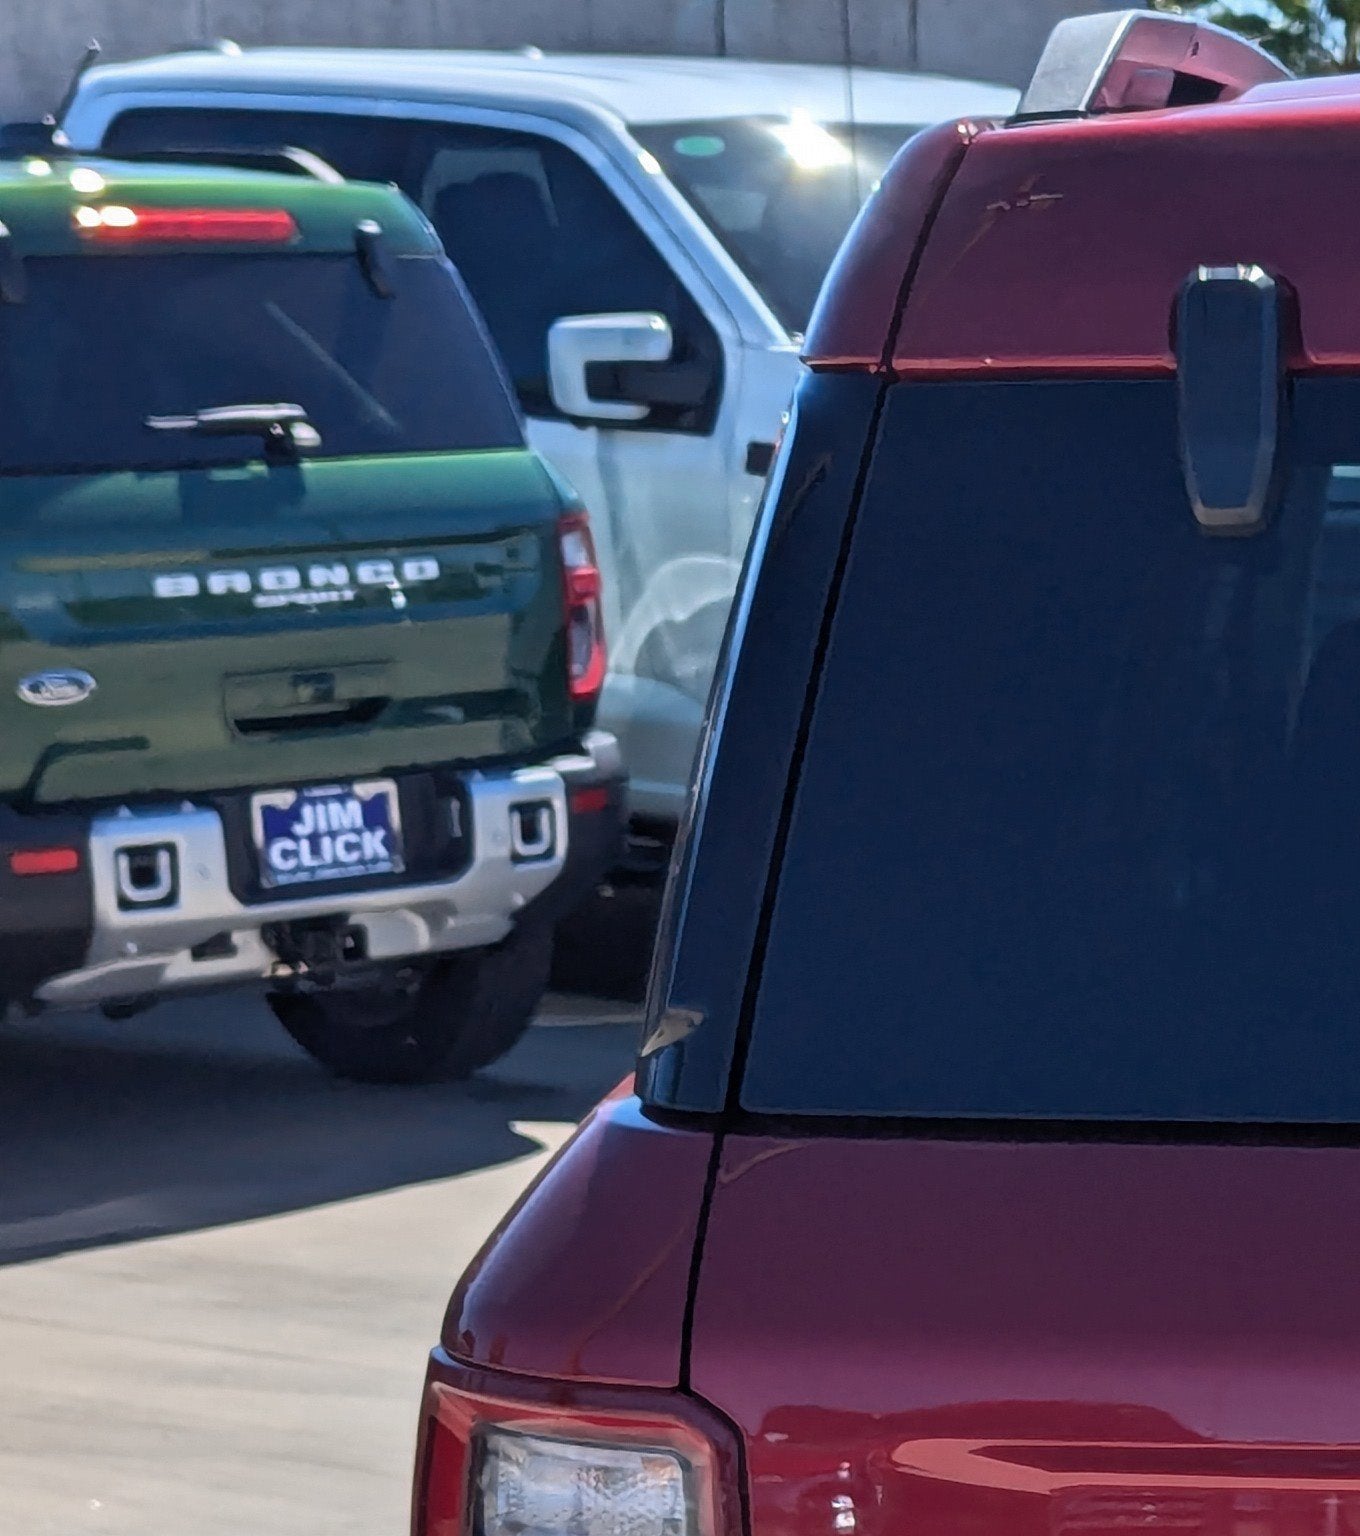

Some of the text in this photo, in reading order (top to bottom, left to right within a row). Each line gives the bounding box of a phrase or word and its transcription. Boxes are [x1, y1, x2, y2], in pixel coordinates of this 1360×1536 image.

[153, 557, 440, 598] BRONCO
[290, 798, 365, 837] JIM
[269, 825, 391, 872] CLICK
